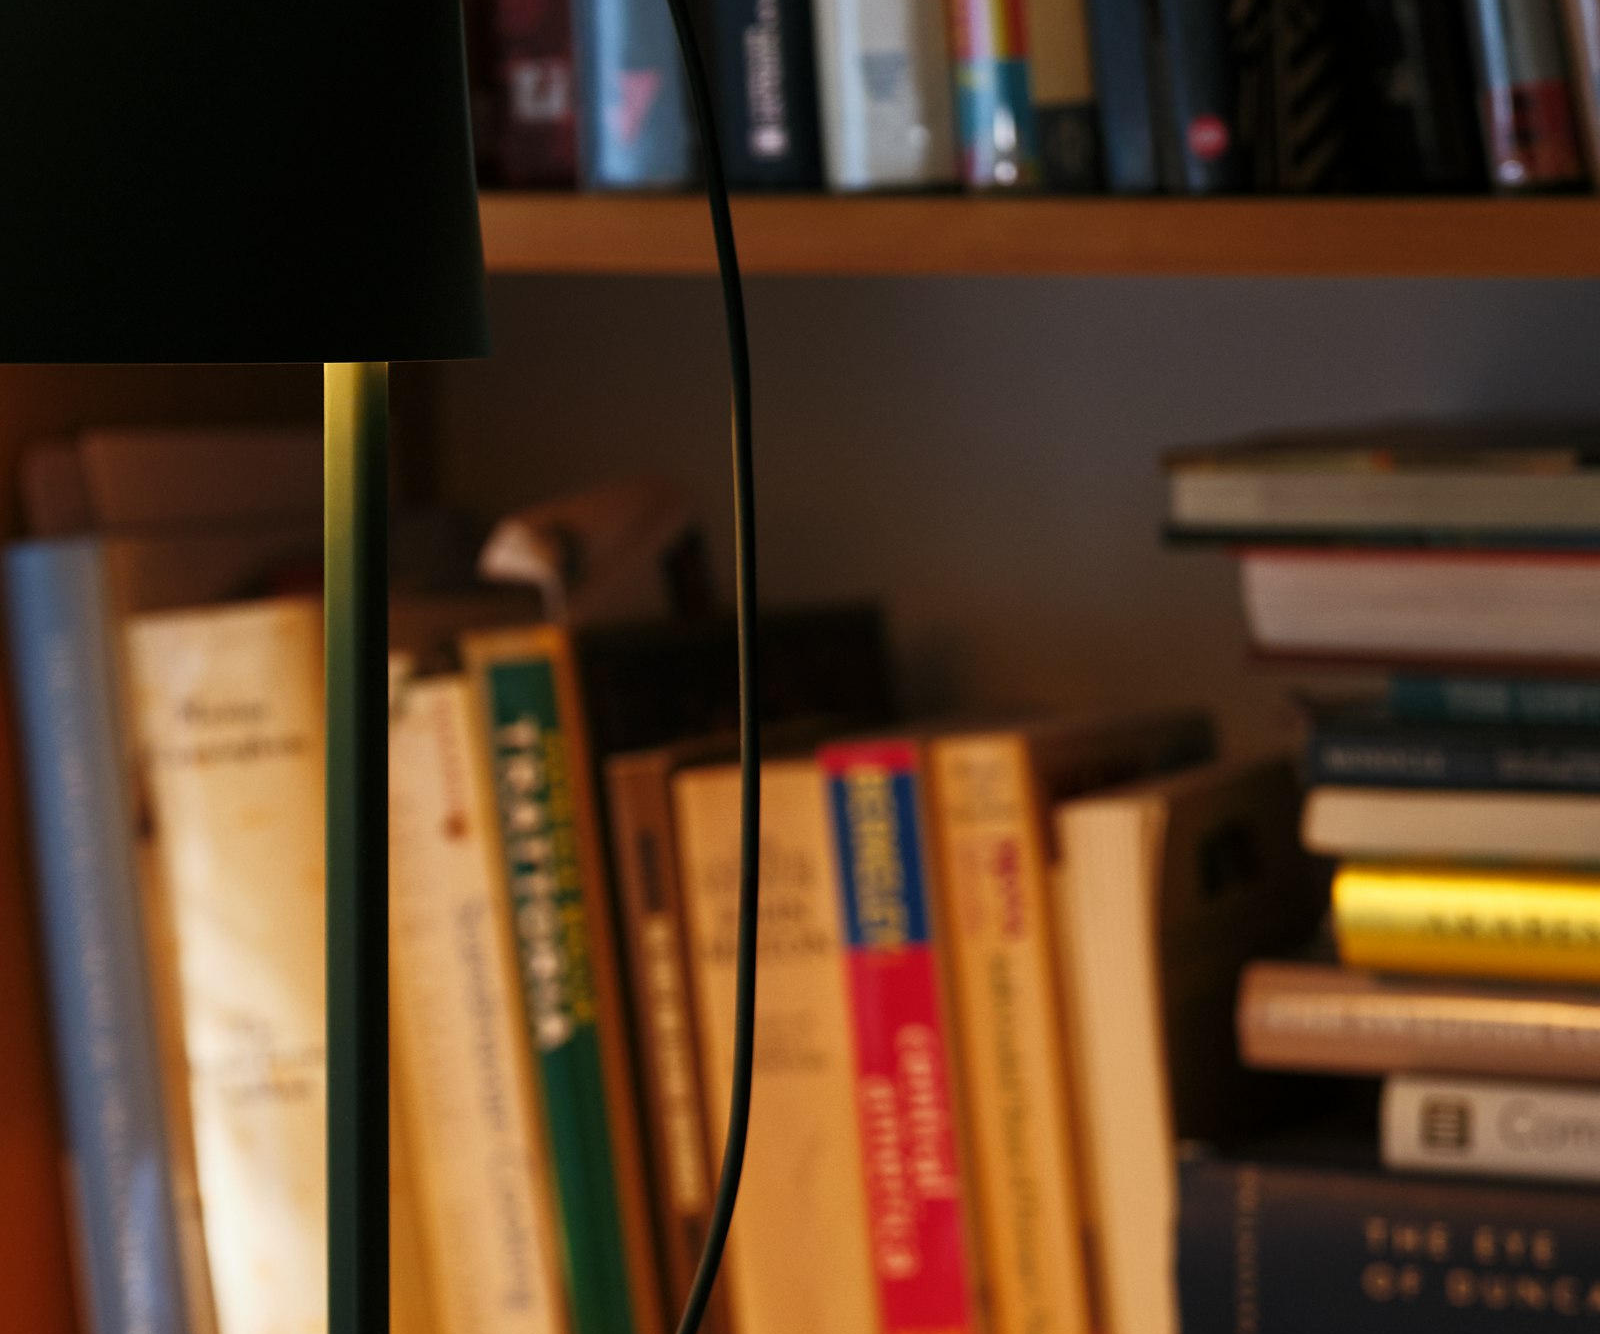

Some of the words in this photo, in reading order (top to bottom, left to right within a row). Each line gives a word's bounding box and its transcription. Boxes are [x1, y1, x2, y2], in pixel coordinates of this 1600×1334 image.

[495, 713, 574, 1051] TRATTORIA
[1364, 1215, 1450, 1264] THE
[1472, 1223, 1554, 1268] EYE
[1361, 1260, 1423, 1301] OF
